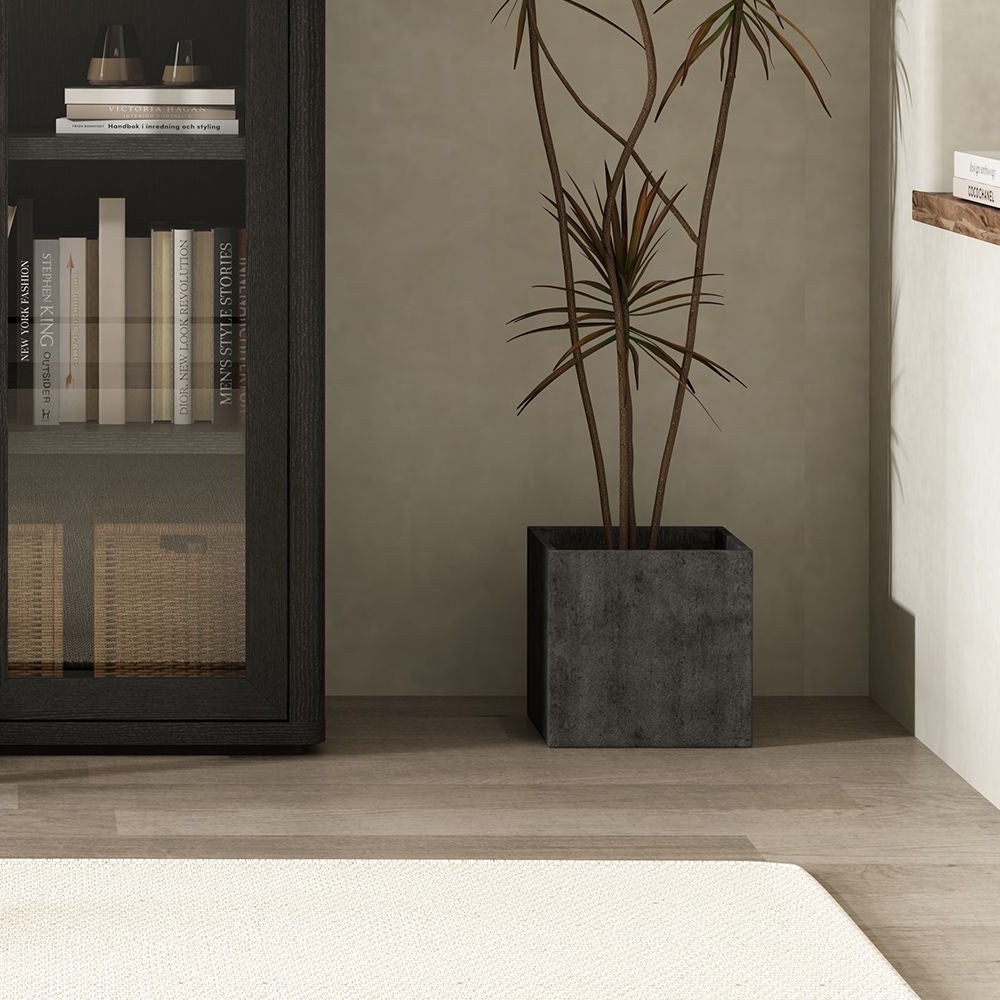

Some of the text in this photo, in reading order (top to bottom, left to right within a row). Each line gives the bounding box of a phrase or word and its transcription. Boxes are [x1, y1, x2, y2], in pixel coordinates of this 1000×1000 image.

[145, 123, 180, 131] inredning
[197, 123, 221, 131] styling
[20, 260, 30, 362] NEW YORK FASHION
[179, 239, 189, 315] REVOLUTION
[39, 253, 54, 403] STEPHEN KING OUTSIDER
[179, 318, 189, 351] LOOK
[219, 242, 233, 406] MEN'S STYLE STORIES
[179, 353, 189, 381] NEW
